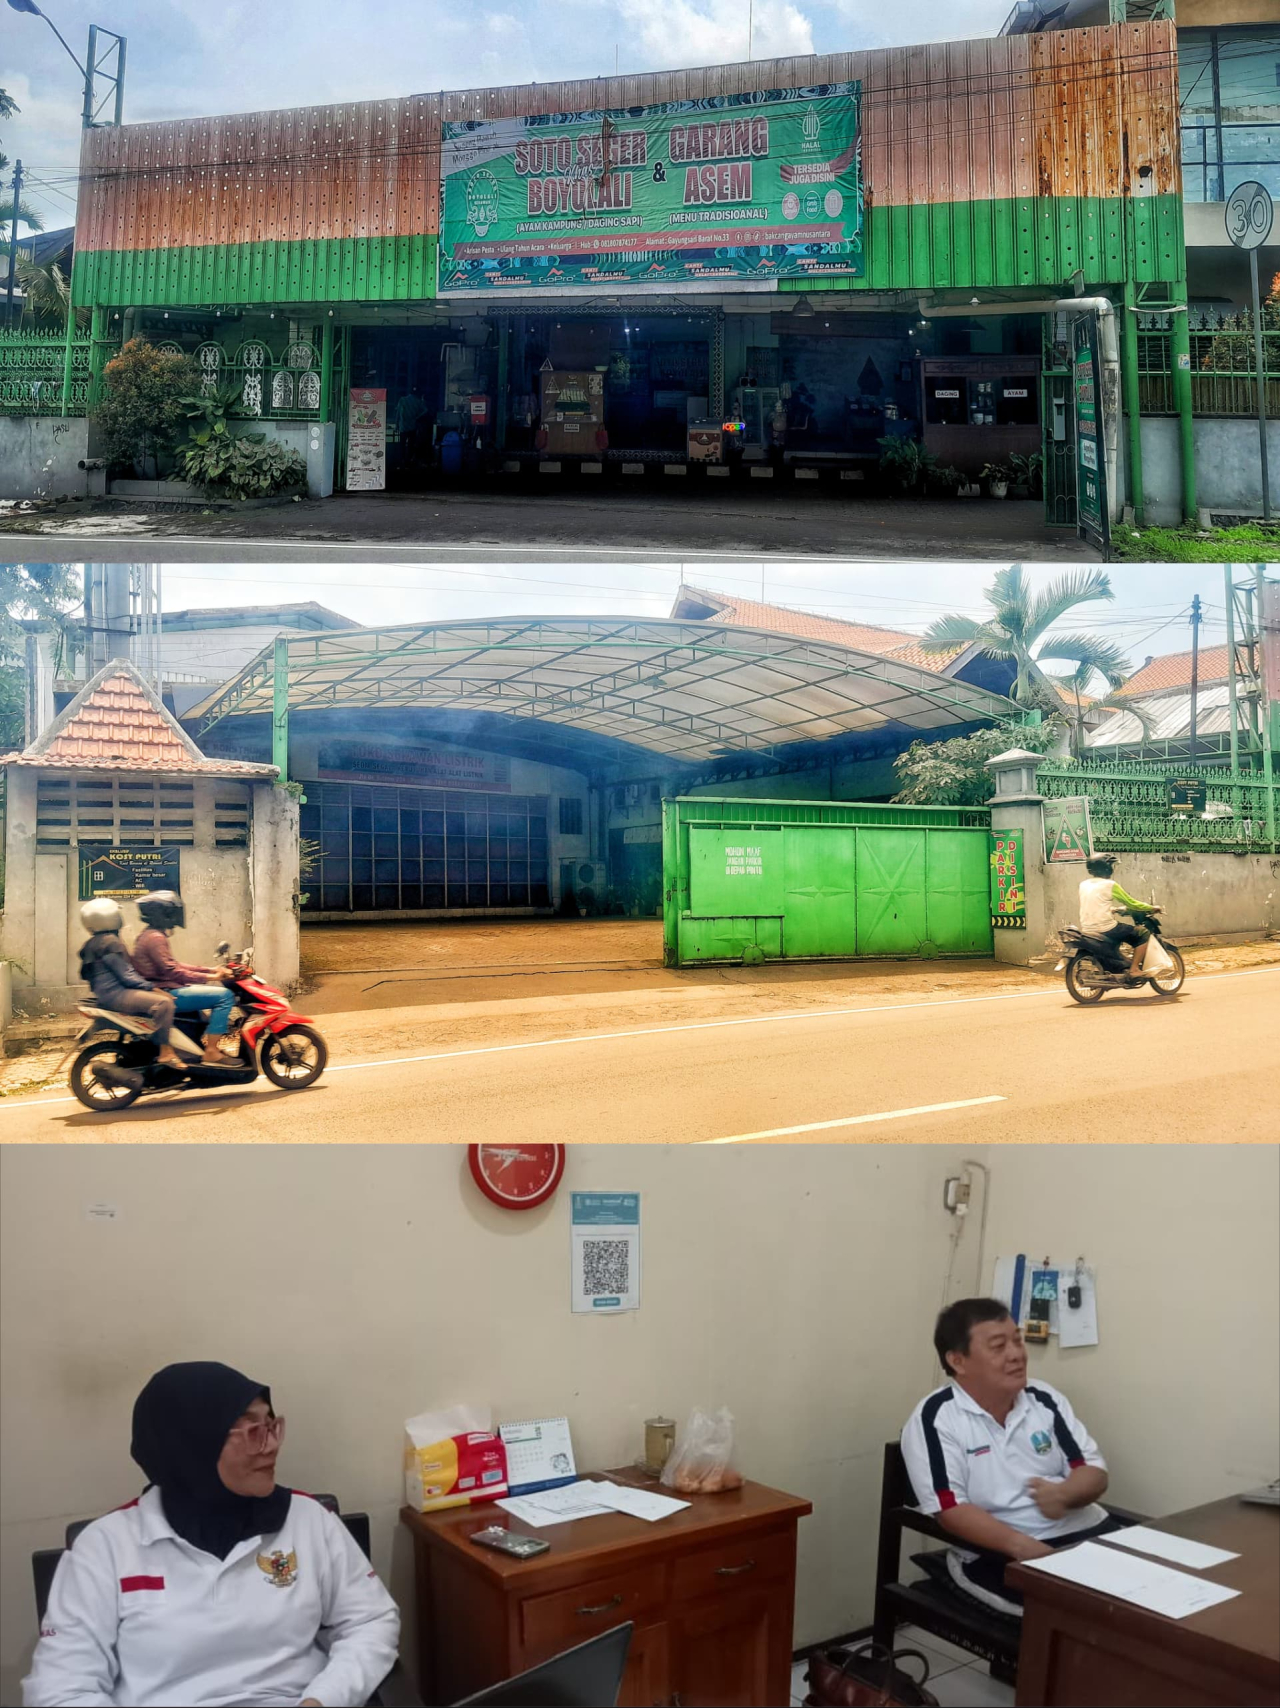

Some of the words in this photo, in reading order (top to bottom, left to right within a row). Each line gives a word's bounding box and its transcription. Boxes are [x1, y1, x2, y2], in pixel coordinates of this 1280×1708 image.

[669, 115, 769, 163] GARANG
[515, 135, 572, 175] SOTO
[563, 164, 597, 186] Khas
[652, 161, 667, 183] &
[793, 163, 831, 174] TERSEDIA
[683, 161, 753, 205] ASEM
[789, 174, 811, 185] JUGA
[811, 172, 834, 184] DISINI
[527, 172, 633, 214] BOYOLALI
[516, 221, 541, 233] (AYAM
[542, 219, 583, 232] KAMPUNG
[588, 217, 619, 229] DAGING
[620, 215, 643, 227] SAPI)
[669, 211, 697, 225] (MENU
[698, 208, 769, 222] TRADISIOANAL)
[1231, 198, 1269, 238] 30
[698, 235, 713, 243] Barat
[714, 233, 729, 242] No.33
[481, 246, 495, 254] Pesta
[515, 244, 530, 252] Tahun
[531, 243, 545, 251] Acara
[538, 275, 575, 283] GoPro
[638, 271, 677, 279] GoPro
[746, 267, 789, 275] GoPro
[444, 279, 479, 287] GoPro
[352, 744, 383, 759] TOKO
[444, 753, 485, 769] LISTRIK
[996, 840, 1006, 913] PARKIR
[1007, 840, 1018, 912] DISINI
